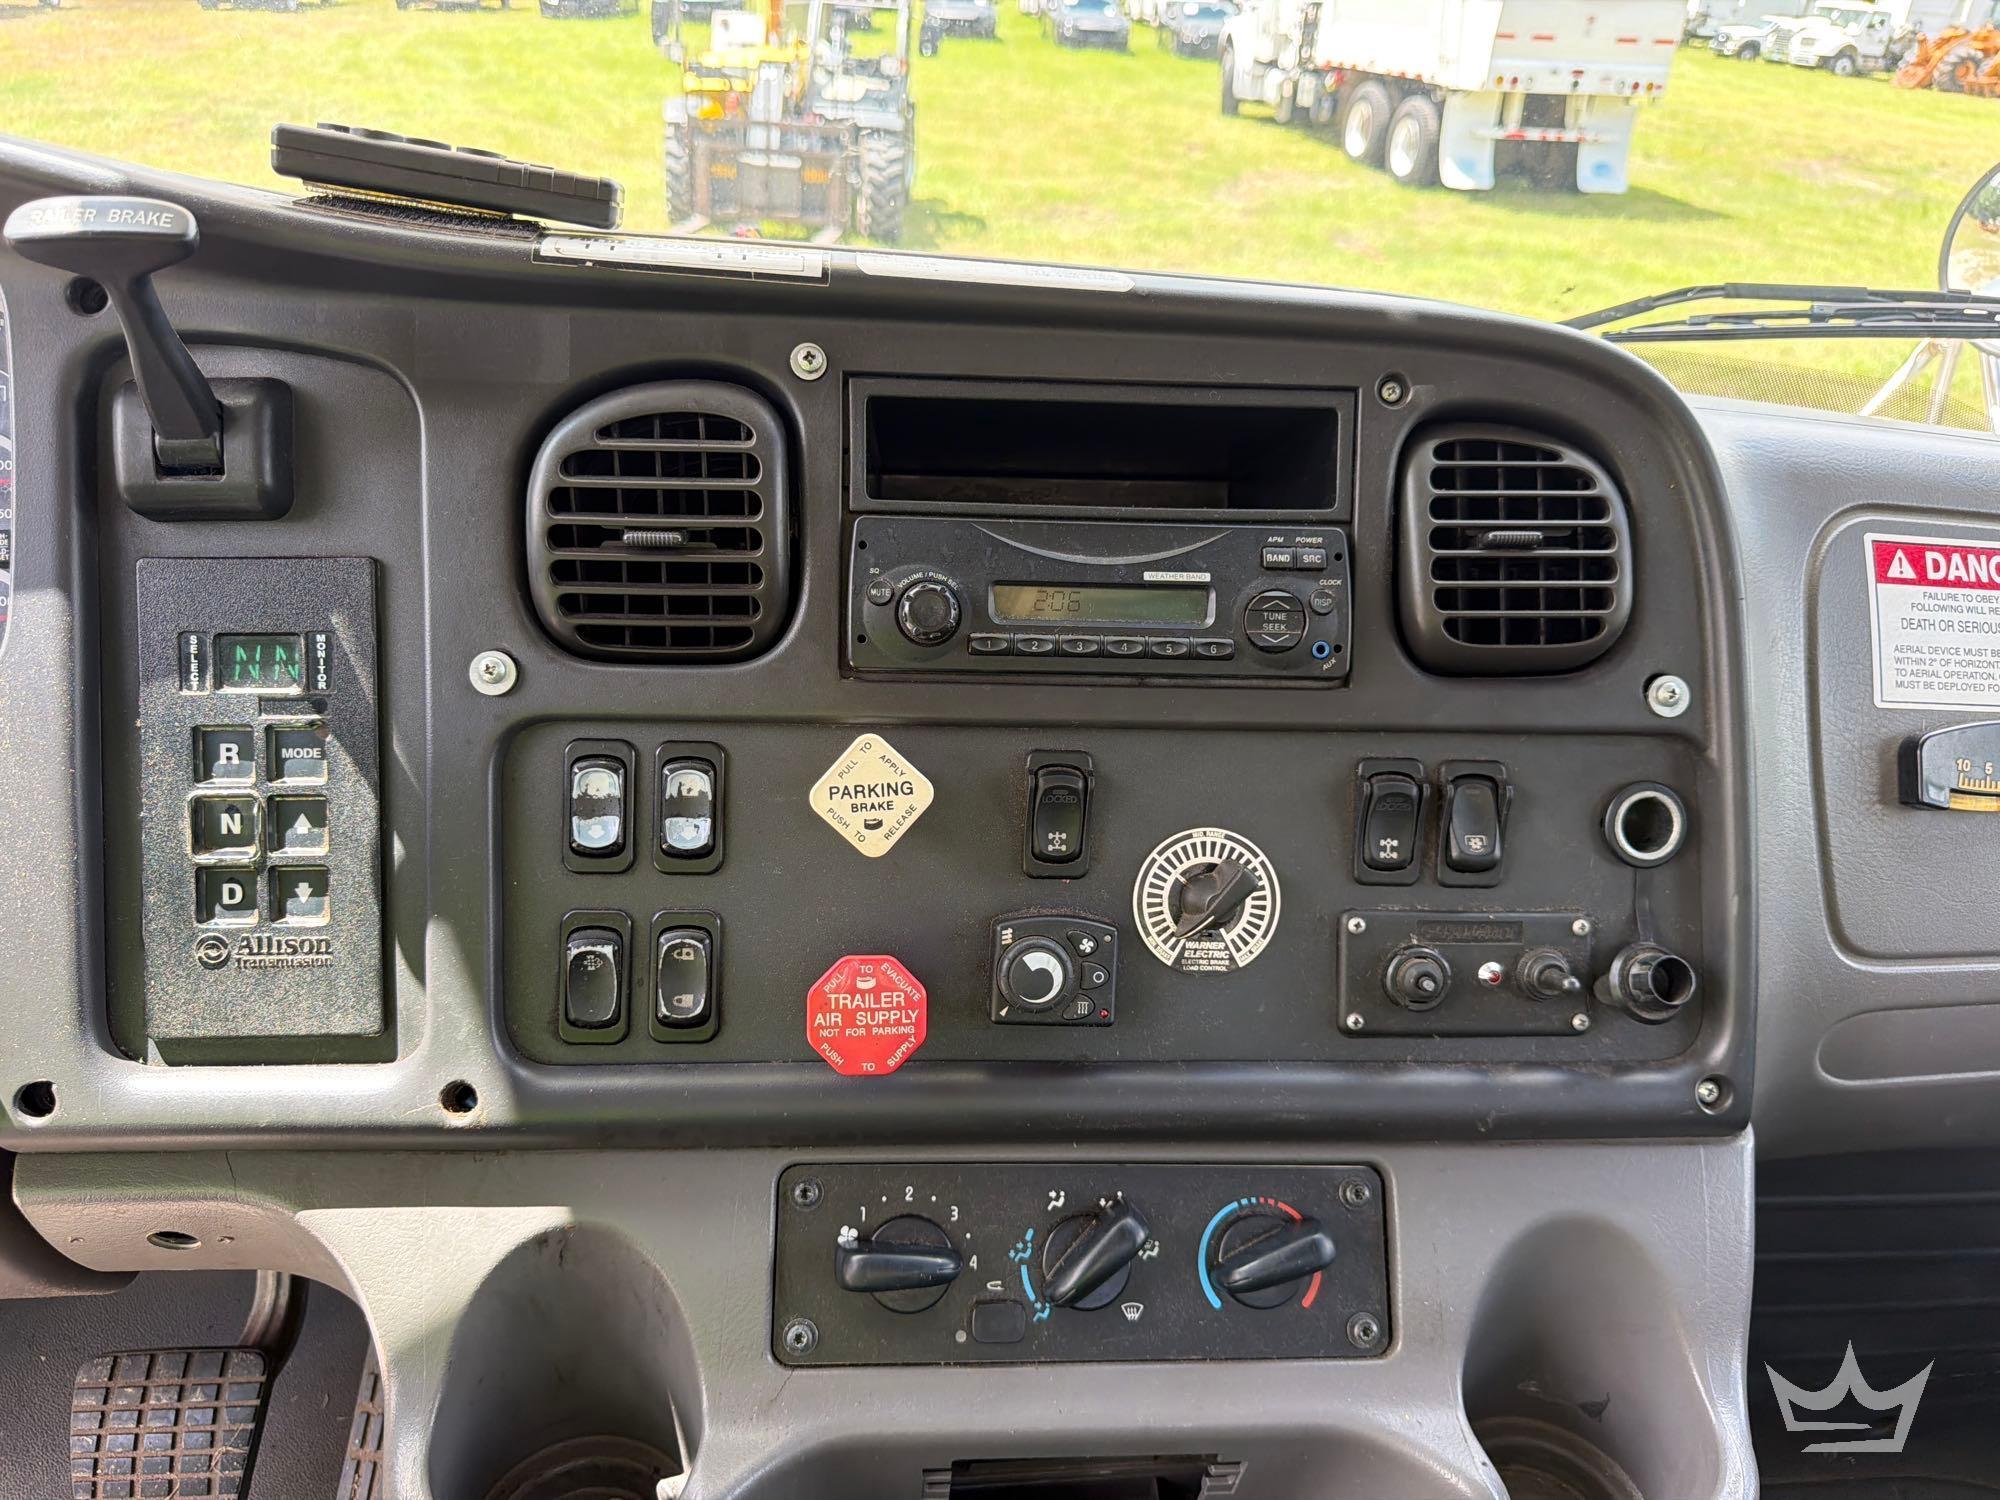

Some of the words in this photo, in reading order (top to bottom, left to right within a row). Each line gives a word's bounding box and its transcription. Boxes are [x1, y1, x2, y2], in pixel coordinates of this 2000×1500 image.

[28, 207, 97, 226] RAILER
[107, 208, 175, 228] BRAKE
[1295, 536, 1323, 544] POWER
[1266, 554, 1290, 563] BAND
[1302, 554, 1322, 563] SRC
[897, 571, 924, 588] VOLUME
[928, 571, 948, 582] PUSH
[1148, 572, 1185, 580] WEATHER
[870, 588, 891, 597] MUTE
[1922, 591, 1959, 602] FAILURE
[1961, 593, 1974, 603] TO
[1975, 594, 1999, 604] OBEY
[1033, 589, 1081, 612] 2:06
[1911, 603, 1963, 614] FOLLOWING
[1965, 605, 1986, 615] WILL
[1263, 612, 1288, 621] TUNE
[1262, 623, 1288, 631] SEEK
[1901, 617, 1936, 631] DEATH
[1939, 619, 1955, 632] OR
[986, 640, 991, 649] 1
[1031, 640, 1038, 650] 2
[1076, 641, 1083, 650] 3
[1121, 642, 1128, 652] 4
[1165, 643, 1172, 653] 5
[1210, 644, 1217, 654] 6
[1893, 645, 1926, 655] AERIAL
[1928, 646, 1961, 656] DEVICE
[1963, 648, 1988, 658] MUST
[189, 635, 199, 691] SELECT
[315, 634, 328, 691] MONITOR
[1322, 657, 1337, 671] AUX
[1894, 656, 1927, 666] WITHIN
[1940, 658, 1952, 667] OF
[1954, 659, 2000, 669] HORIZONT
[1895, 668, 1907, 678] TO
[1909, 669, 1942, 679] AERIAL
[1895, 680, 1921, 690] MUST
[1923, 681, 1936, 690] BE
[1937, 681, 1986, 692] DEPLOYED
[219, 743, 241, 765] R
[281, 747, 322, 759] MODE
[837, 759, 858, 780] PULL
[859, 741, 872, 754] TO
[879, 754, 907, 778] APPLY
[1956, 759, 1971, 772] 10
[1985, 762, 1993, 775] 5
[829, 780, 914, 801] PARKING
[850, 800, 895, 813] BRAKE
[220, 813, 242, 835] N
[826, 807, 851, 830] PUSH
[853, 830, 866, 843] TO
[883, 803, 918, 841] RELEASE
[222, 883, 244, 905] D
[234, 933, 334, 956] Allison
[1185, 941, 1226, 950] WARNER
[1183, 949, 1230, 959] ELECTRIC
[233, 956, 333, 970] Transmission
[823, 966, 849, 993] PULL
[860, 965, 873, 974] TO
[881, 962, 921, 1002] EVACUATE
[827, 991, 905, 1010] TRAILER
[814, 1012, 842, 1027] AIR
[856, 1009, 919, 1026] SUPPLY
[819, 1028, 840, 1038] NOT
[845, 1027, 866, 1037] FOR
[872, 1025, 915, 1036] PARKING
[820, 1042, 844, 1066] PUSH
[861, 1062, 876, 1071] TO
[886, 1034, 918, 1068] SUPPLY
[904, 1185, 914, 1202] 2
[860, 1205, 866, 1222] 1
[950, 1205, 959, 1221] 3
[969, 1254, 978, 1271] 4
